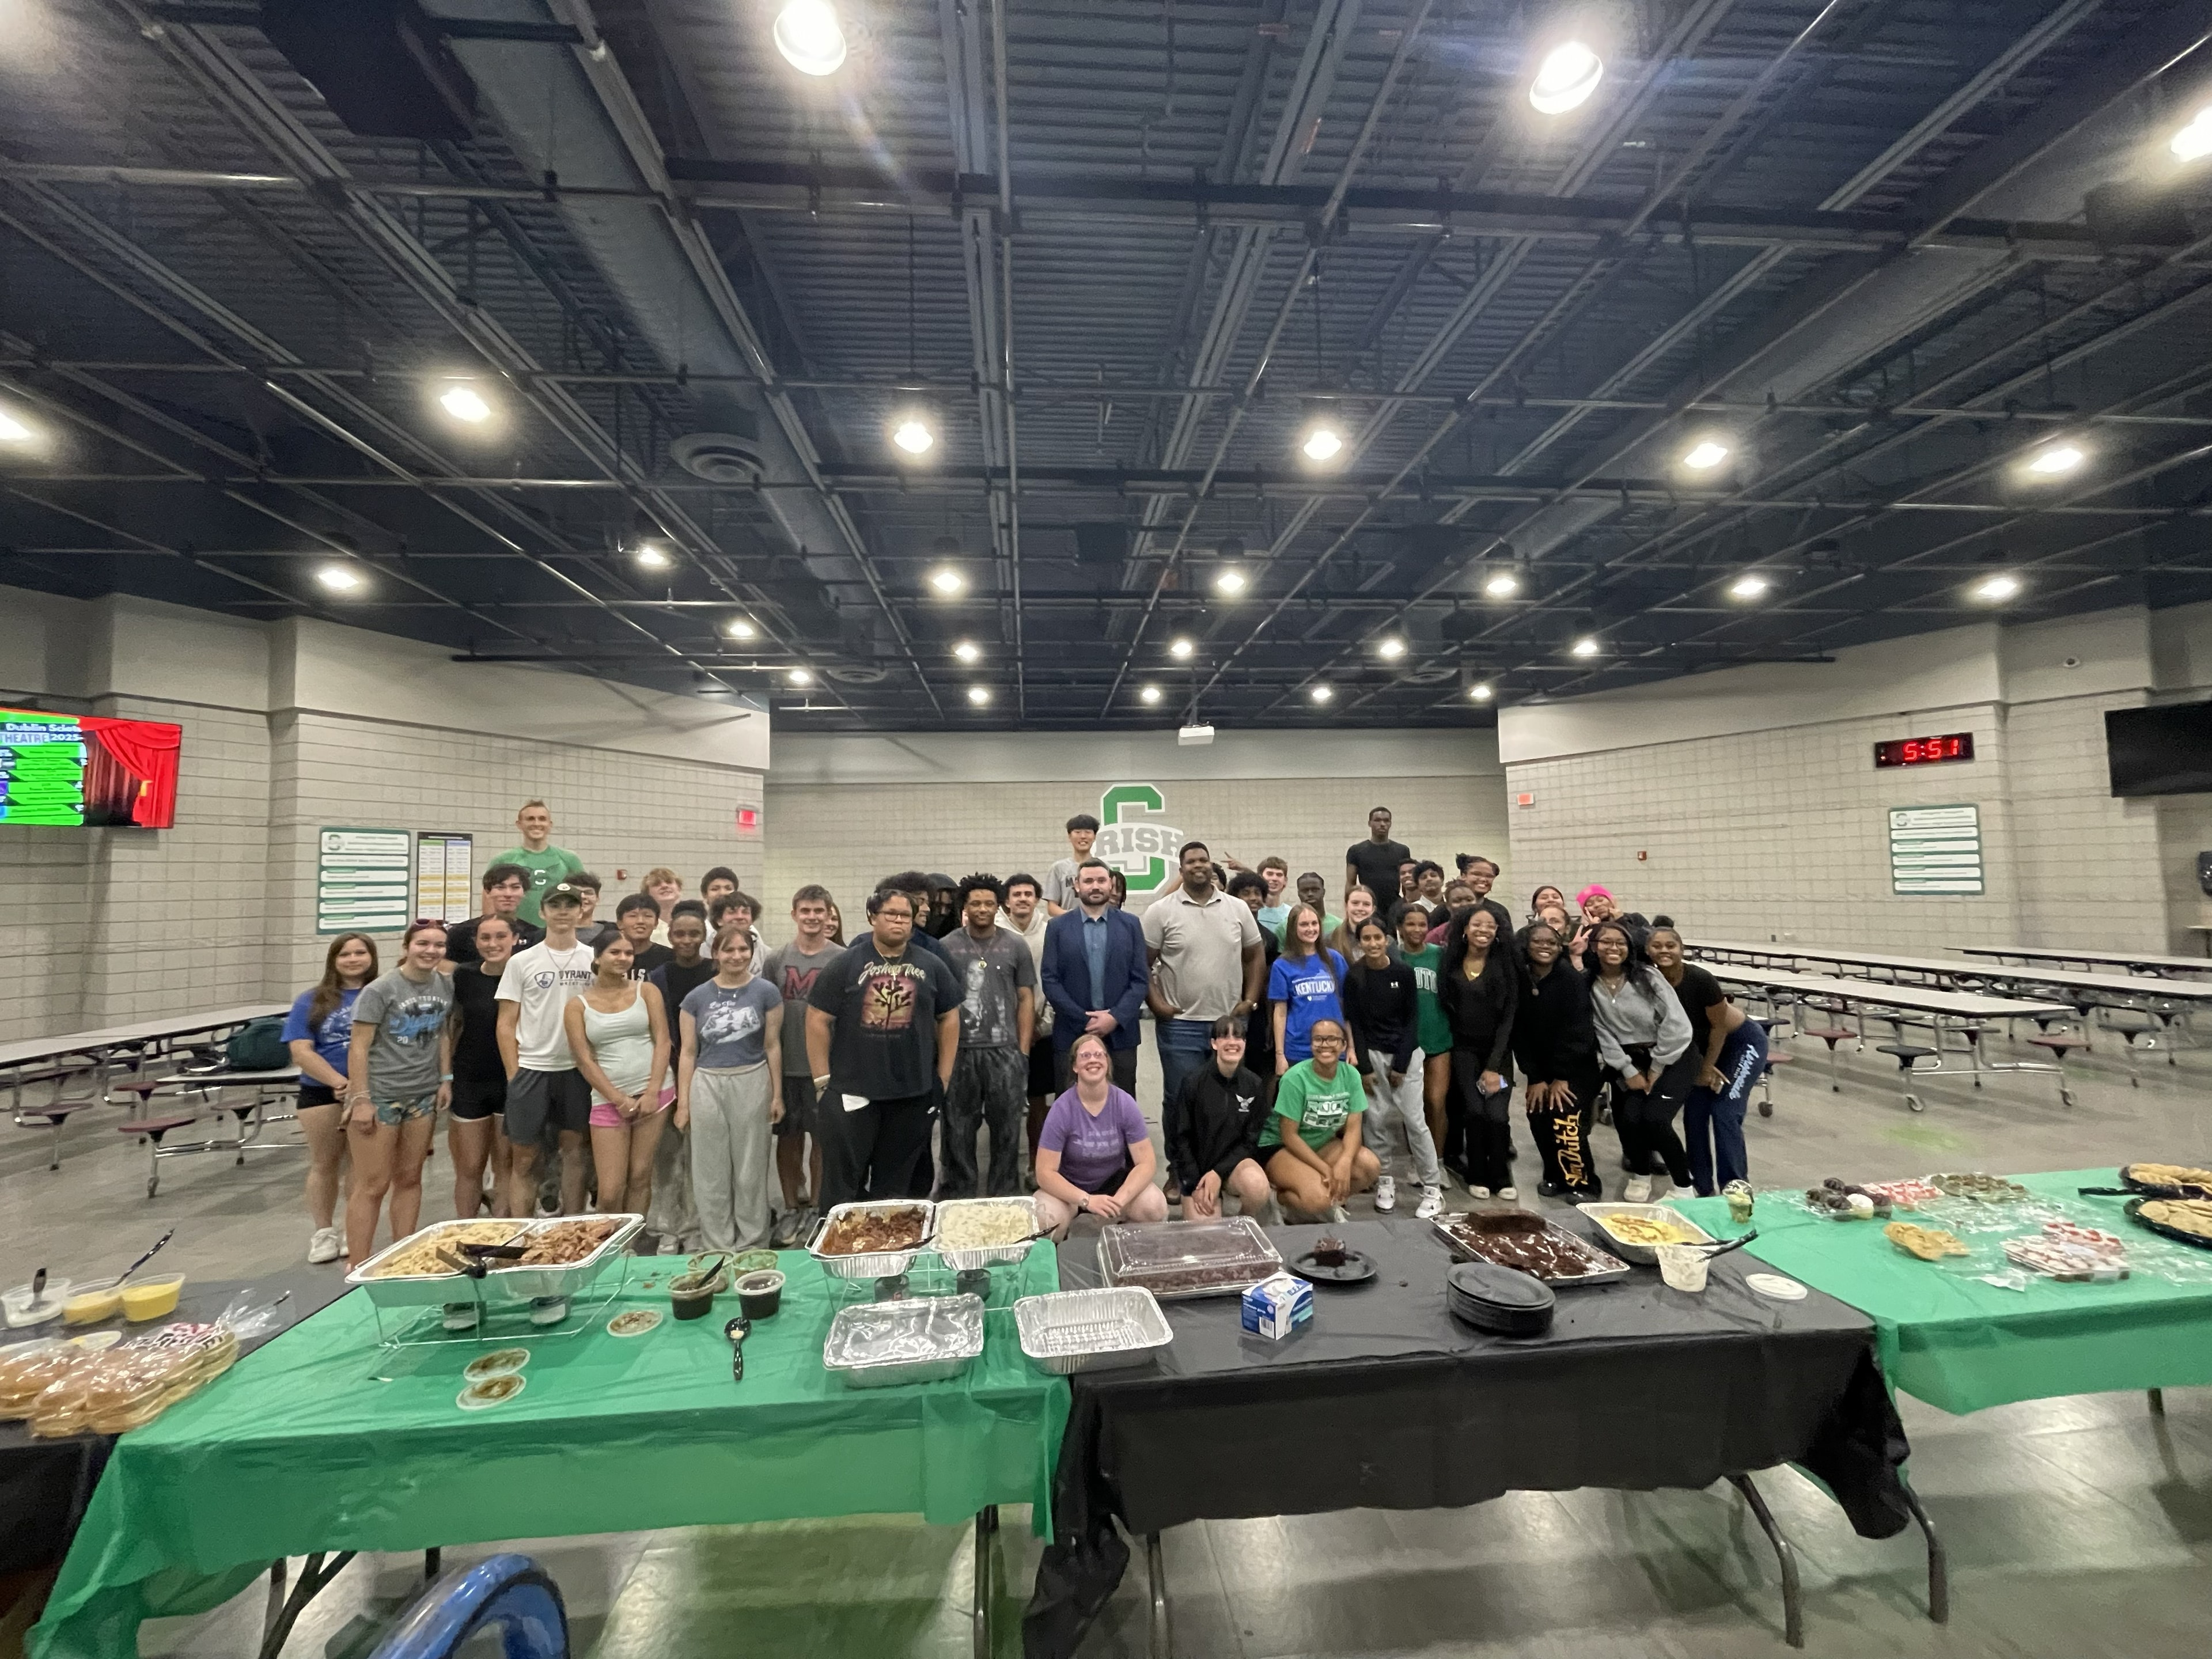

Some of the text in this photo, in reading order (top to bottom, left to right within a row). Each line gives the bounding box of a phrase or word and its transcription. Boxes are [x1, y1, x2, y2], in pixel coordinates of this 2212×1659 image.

[6, 723, 47, 732] Dublin
[1904, 739, 1959, 761] 5:51
[1095, 828, 1184, 858] RISH
[784, 965, 823, 999] M
[858, 961, 926, 985] Joshua Tree
